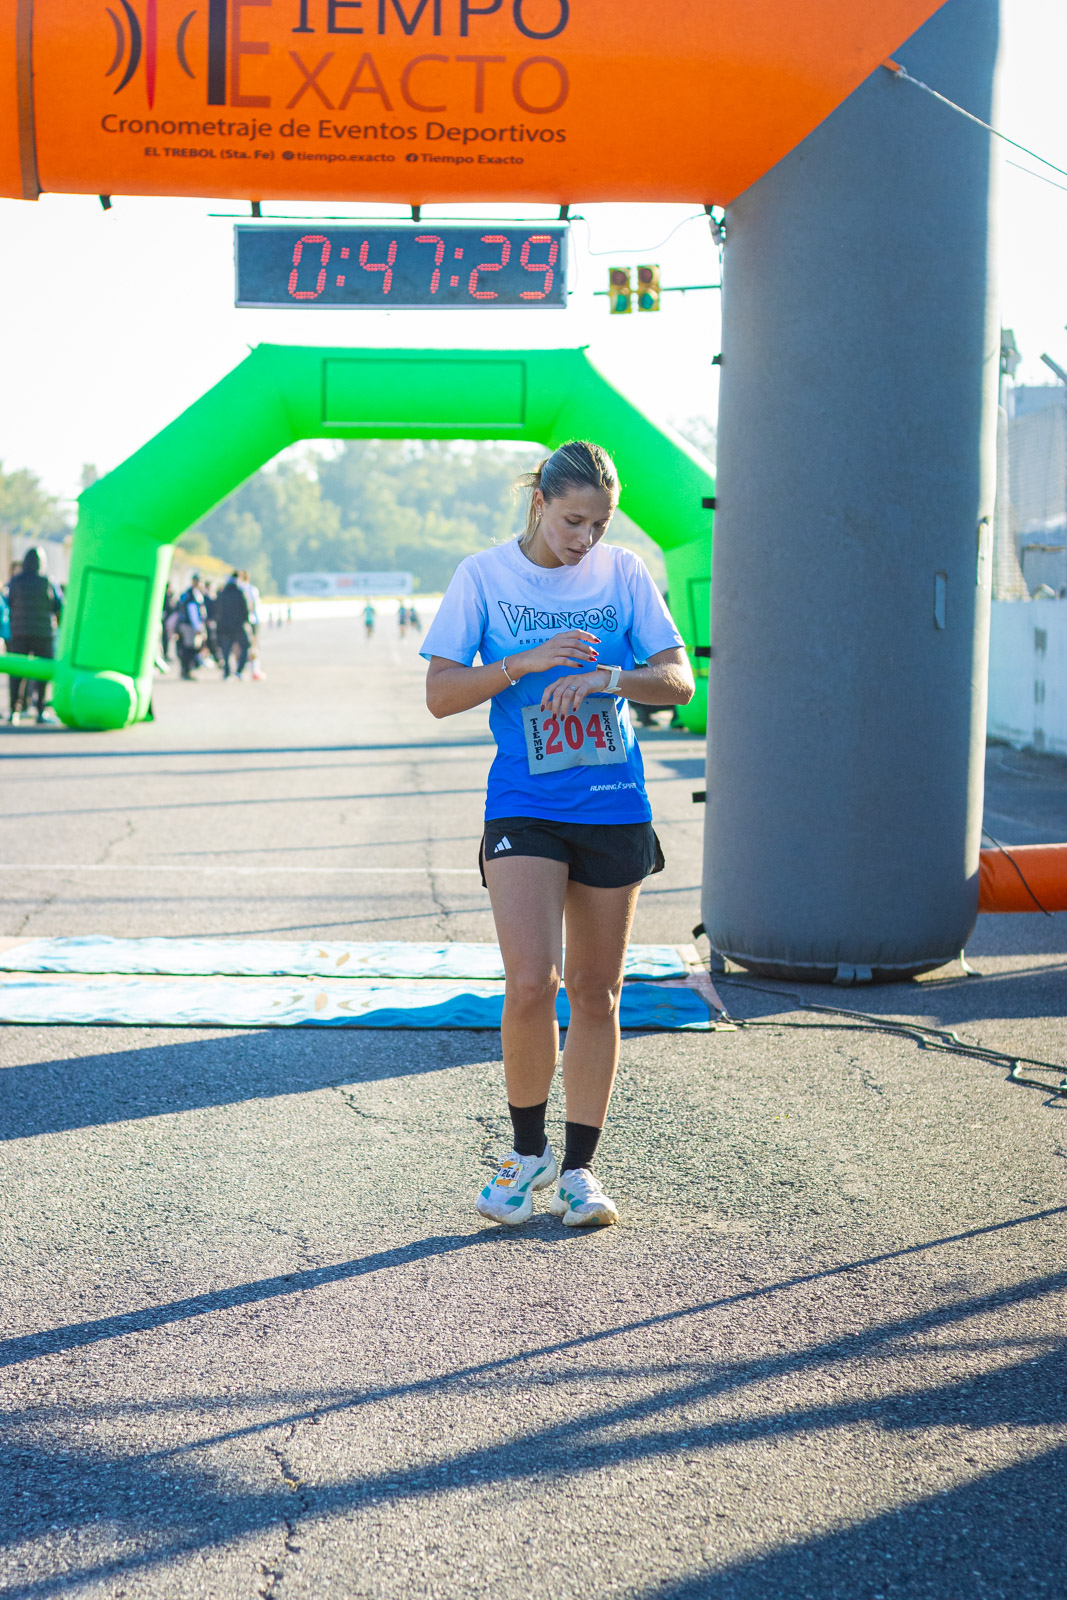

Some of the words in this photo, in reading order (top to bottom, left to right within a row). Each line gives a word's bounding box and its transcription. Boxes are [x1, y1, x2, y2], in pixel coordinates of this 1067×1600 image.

[101, 114, 272, 141] Cronometraje
[279, 118, 311, 138] de
[319, 120, 418, 139] Eventos
[426, 122, 566, 145] Deportivos
[144, 147, 160, 157] EL
[163, 148, 216, 158] TREBOL
[220, 149, 251, 159] (Sta.
[254, 150, 275, 160] Fe)
[421, 153, 474, 165] Tiempo
[478, 154, 524, 164] Exacto
[530, 718, 544, 760] TIEMPO
[543, 714, 606, 755] 204
[601, 711, 616, 752] EXACTO
